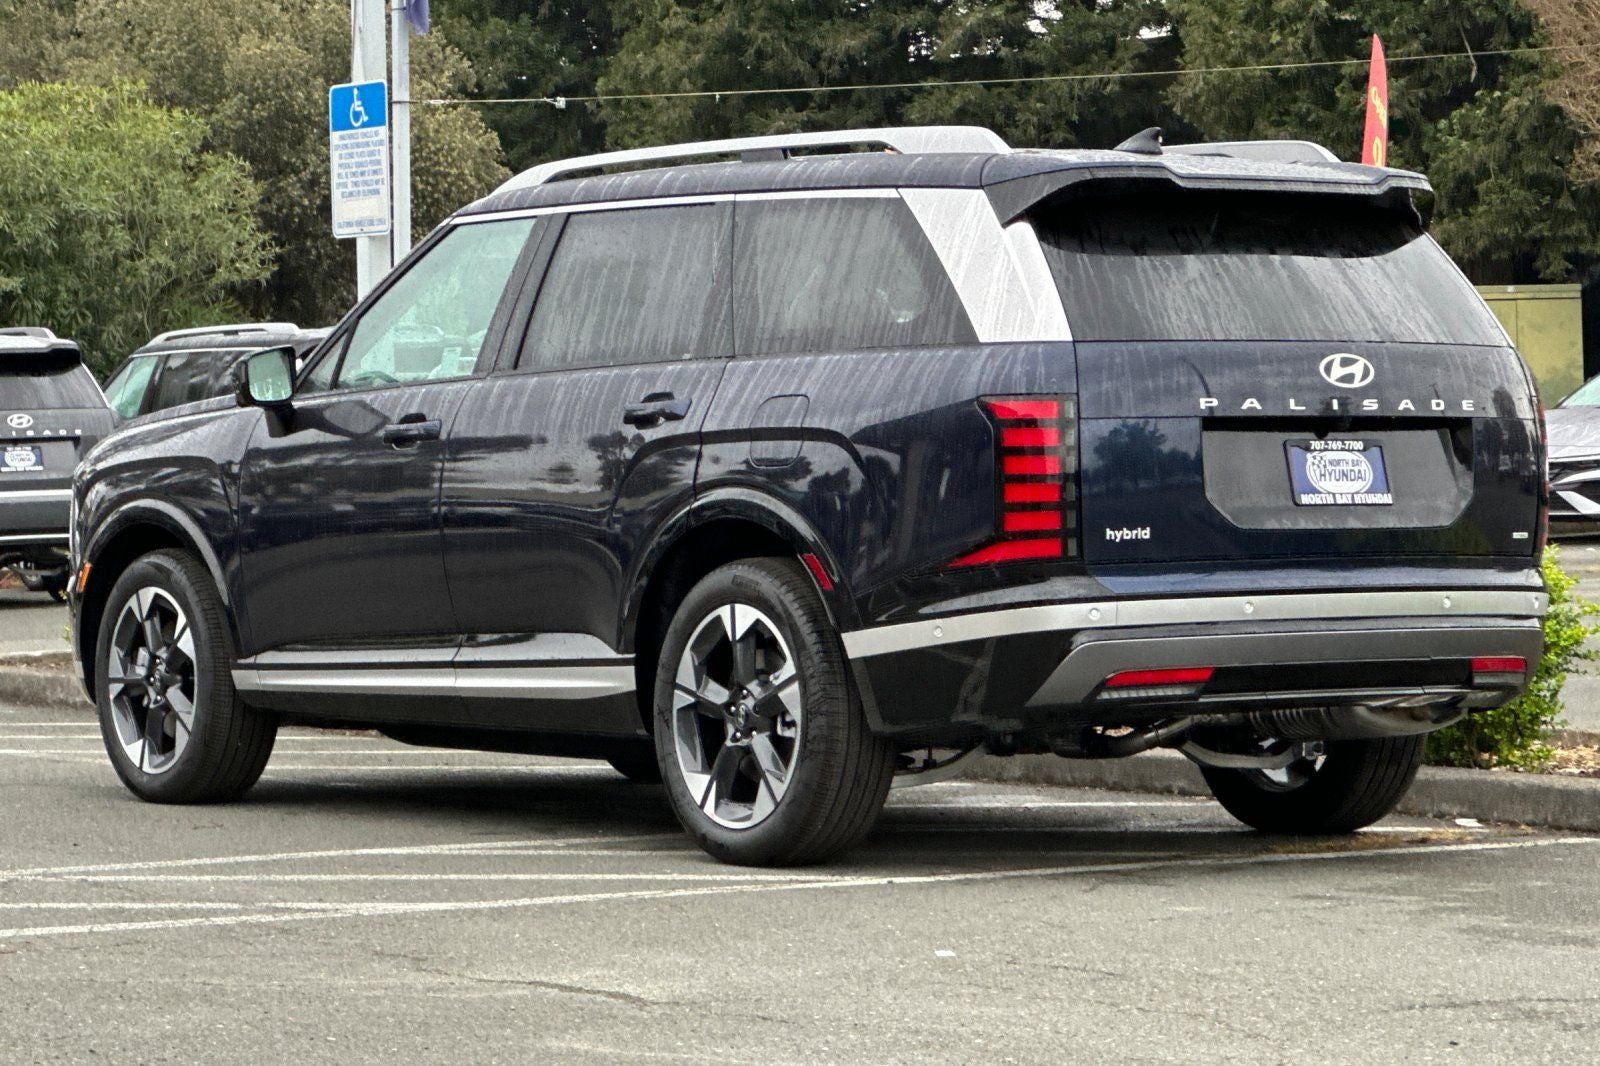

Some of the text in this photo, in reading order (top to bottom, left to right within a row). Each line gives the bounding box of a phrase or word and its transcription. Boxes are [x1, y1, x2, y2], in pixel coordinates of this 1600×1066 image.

[1198, 397, 1475, 411] PALISADE
[1309, 440, 1364, 451] 707-769-7700
[1327, 458, 1363, 468] NORTH BAY
[1319, 468, 1367, 482] HYUNDAI
[1300, 493, 1393, 505] NORTH BAY HYUNDAI
[1105, 526, 1151, 543] hybrid
